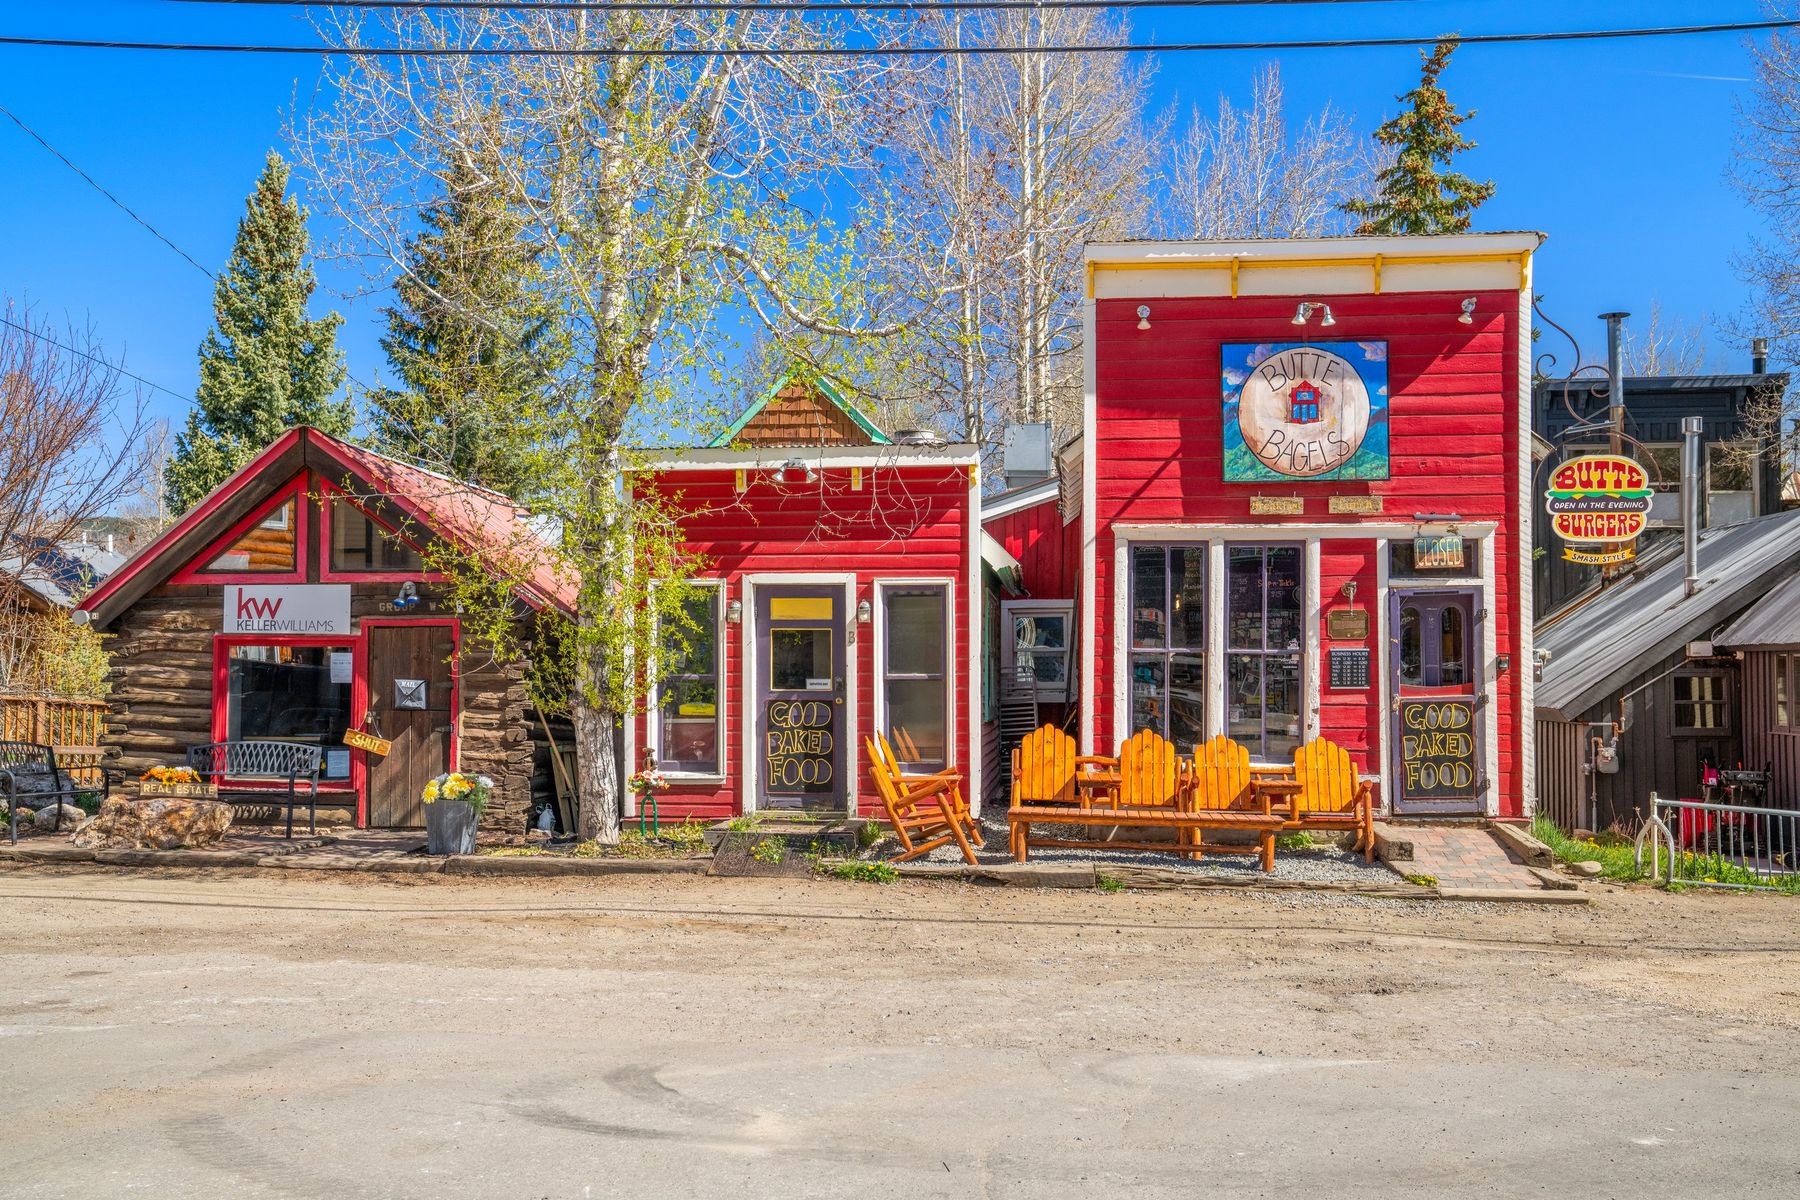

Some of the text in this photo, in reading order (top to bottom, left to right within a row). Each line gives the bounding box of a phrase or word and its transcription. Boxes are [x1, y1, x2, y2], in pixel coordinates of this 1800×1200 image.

[1260, 352, 1340, 392] BUTTE
[1258, 429, 1350, 471] BAGELS
[1555, 461, 1643, 489] BUTTE
[1554, 501, 1645, 509] OPEN IN THE EVENING
[1558, 514, 1641, 537] BURGERS
[1416, 538, 1461, 566] CLOSED
[1572, 552, 1626, 563] SMASH STYLE
[237, 588, 283, 619] kw
[770, 702, 831, 728] GOOD
[1405, 704, 1471, 730] GOOD
[351, 734, 381, 752] SHUT
[768, 729, 833, 757] BAKED
[1403, 733, 1473, 760] BAKED
[767, 756, 833, 785] FOOD
[1404, 761, 1473, 790] FOOD
[143, 783, 215, 795] REAL ESTATE
